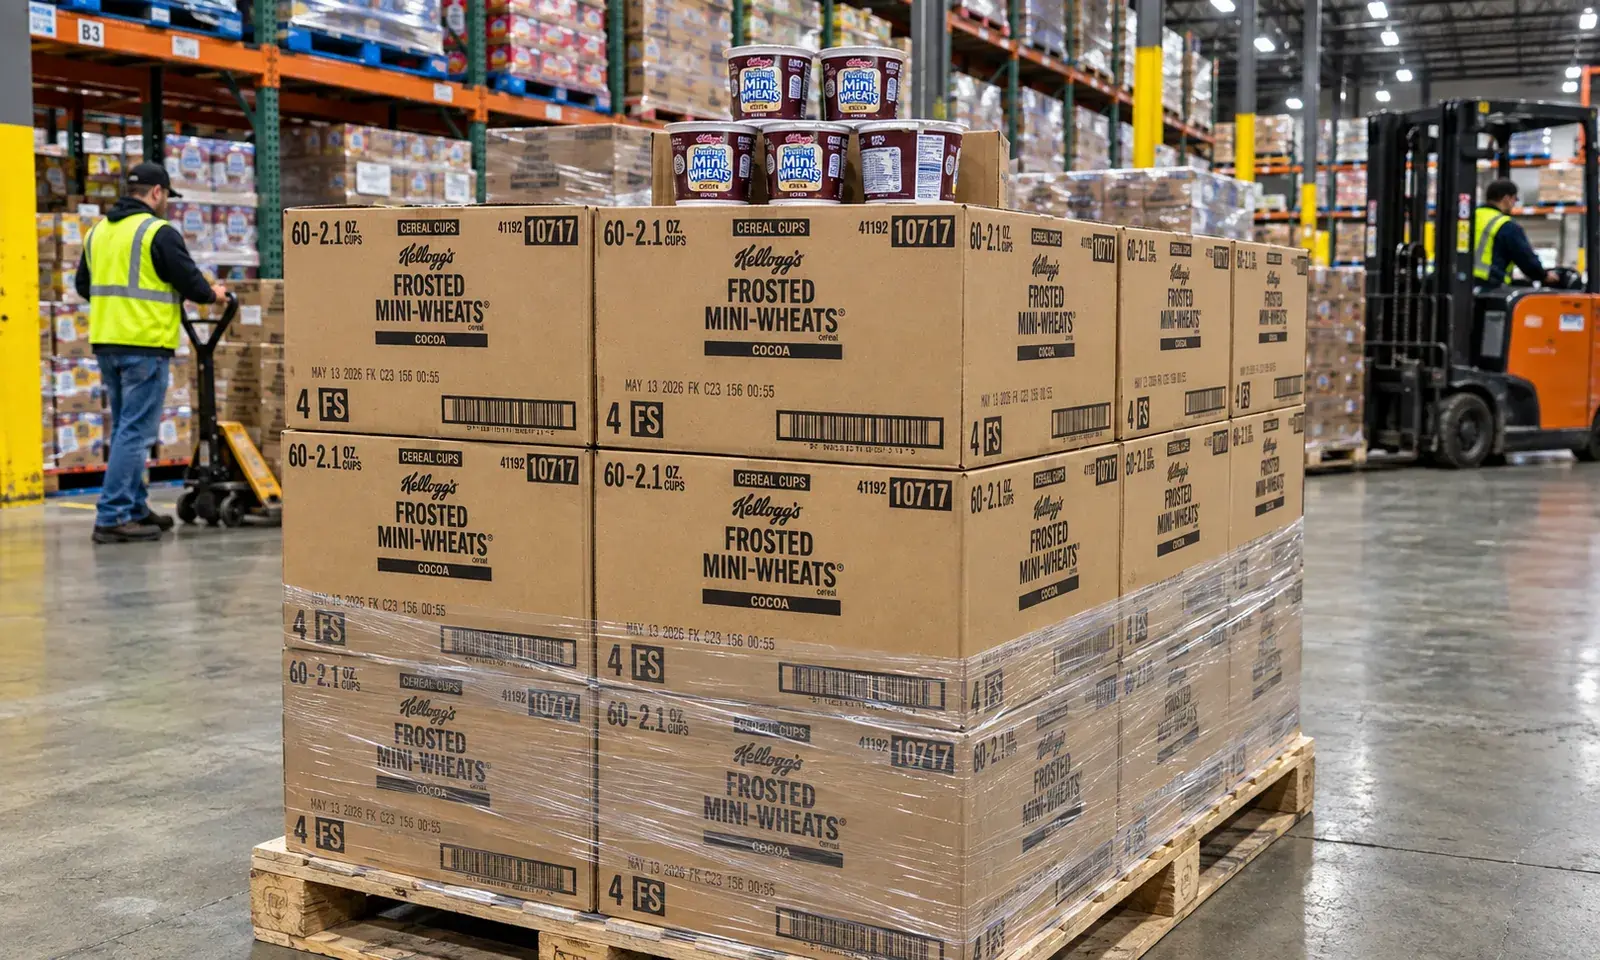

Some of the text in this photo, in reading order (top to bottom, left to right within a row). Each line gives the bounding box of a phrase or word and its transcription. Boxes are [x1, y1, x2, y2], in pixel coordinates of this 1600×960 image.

[82, 24, 100, 42] B3
[292, 220, 360, 246] 60-2.1 OZ.
[344, 234, 362, 246] CUPS
[400, 222, 456, 233] CEREAL CUPS
[498, 220, 575, 244] 41192 10717
[604, 220, 683, 246] 60-2.1 OZ.
[664, 234, 686, 246] CUPS
[737, 222, 806, 234] CEREAL CUPS
[858, 219, 951, 244] 41192 10717
[970, 222, 1000, 251] 60-2.1
[399, 243, 456, 270] Kellogg's
[734, 244, 804, 274] Kellogg's
[1094, 238, 1114, 260] 10717
[1032, 254, 1060, 282] Kellogg's
[394, 274, 464, 296] FROSTED
[728, 278, 815, 303] FROSTED
[1029, 285, 1064, 308] FROSTED
[1168, 288, 1193, 307] FROSTED
[415, 334, 446, 344] COCOA
[752, 344, 790, 356] COCOA
[312, 367, 440, 384] MAY 13 2026 FK C23 156 00:55
[625, 378, 775, 398] MAY 13 2026 FK C23 156 00:55
[296, 389, 346, 418] 4 FS
[1128, 398, 1148, 429] 4 FS
[606, 402, 661, 434] 4 FS
[971, 421, 1000, 456] 4 FS
[289, 444, 358, 470] 60-2.1 OZ.
[342, 460, 362, 471] CUPS
[402, 451, 459, 464] CEREAL CUPS
[500, 456, 576, 482] 41192 10717
[1097, 458, 1116, 482] 10717
[400, 472, 459, 500] Kellogg's
[604, 462, 682, 490] 60-2.1 OZ.
[664, 480, 684, 491] CUPS
[738, 473, 806, 488] CEREAL CUPS
[857, 480, 948, 508] 41192 10717
[971, 481, 1002, 514] 60-2.1
[1165, 484, 1191, 510] FROSTED
[396, 501, 468, 528] FROSTED
[732, 494, 803, 525] Kellogg's
[1034, 495, 1064, 521] Kellogg's
[725, 526, 812, 556] FROSTED
[1030, 520, 1068, 553] FROSTED
[418, 564, 449, 576] COCOA
[369, 598, 378, 610] FK
[383, 599, 397, 612] C23
[403, 601, 417, 614] 156
[422, 602, 446, 616] 00:55
[751, 596, 789, 610] COCOA
[648, 624, 658, 637] 13
[663, 626, 684, 640] 2026
[688, 628, 700, 642] FK
[704, 630, 721, 644] C23
[727, 633, 743, 647] 156
[748, 635, 775, 650] 00:55
[290, 661, 339, 688] 60-2.1
[607, 644, 661, 679] 4 FS
[342, 680, 360, 692] CUPS
[403, 676, 459, 693] CEREAL CUPS
[400, 696, 456, 726] Kellogg's
[607, 701, 687, 733] 60-2.1 OZ.
[395, 722, 466, 754] FROSTED
[668, 723, 688, 736] CUPS
[779, 725, 806, 739] CUPS
[734, 743, 804, 776] Kellogg's
[895, 738, 951, 770] 10717
[1034, 753, 1071, 794] FROSTED
[416, 784, 447, 798] COCOA
[727, 771, 816, 808] FROSTED
[311, 798, 326, 811] MAY
[330, 802, 340, 814] 13
[366, 808, 376, 821] FK
[400, 815, 414, 828] 156
[294, 815, 342, 849] 4 FS
[650, 860, 660, 874] 13
[704, 870, 722, 886] C23
[609, 874, 662, 912] 4 FS
